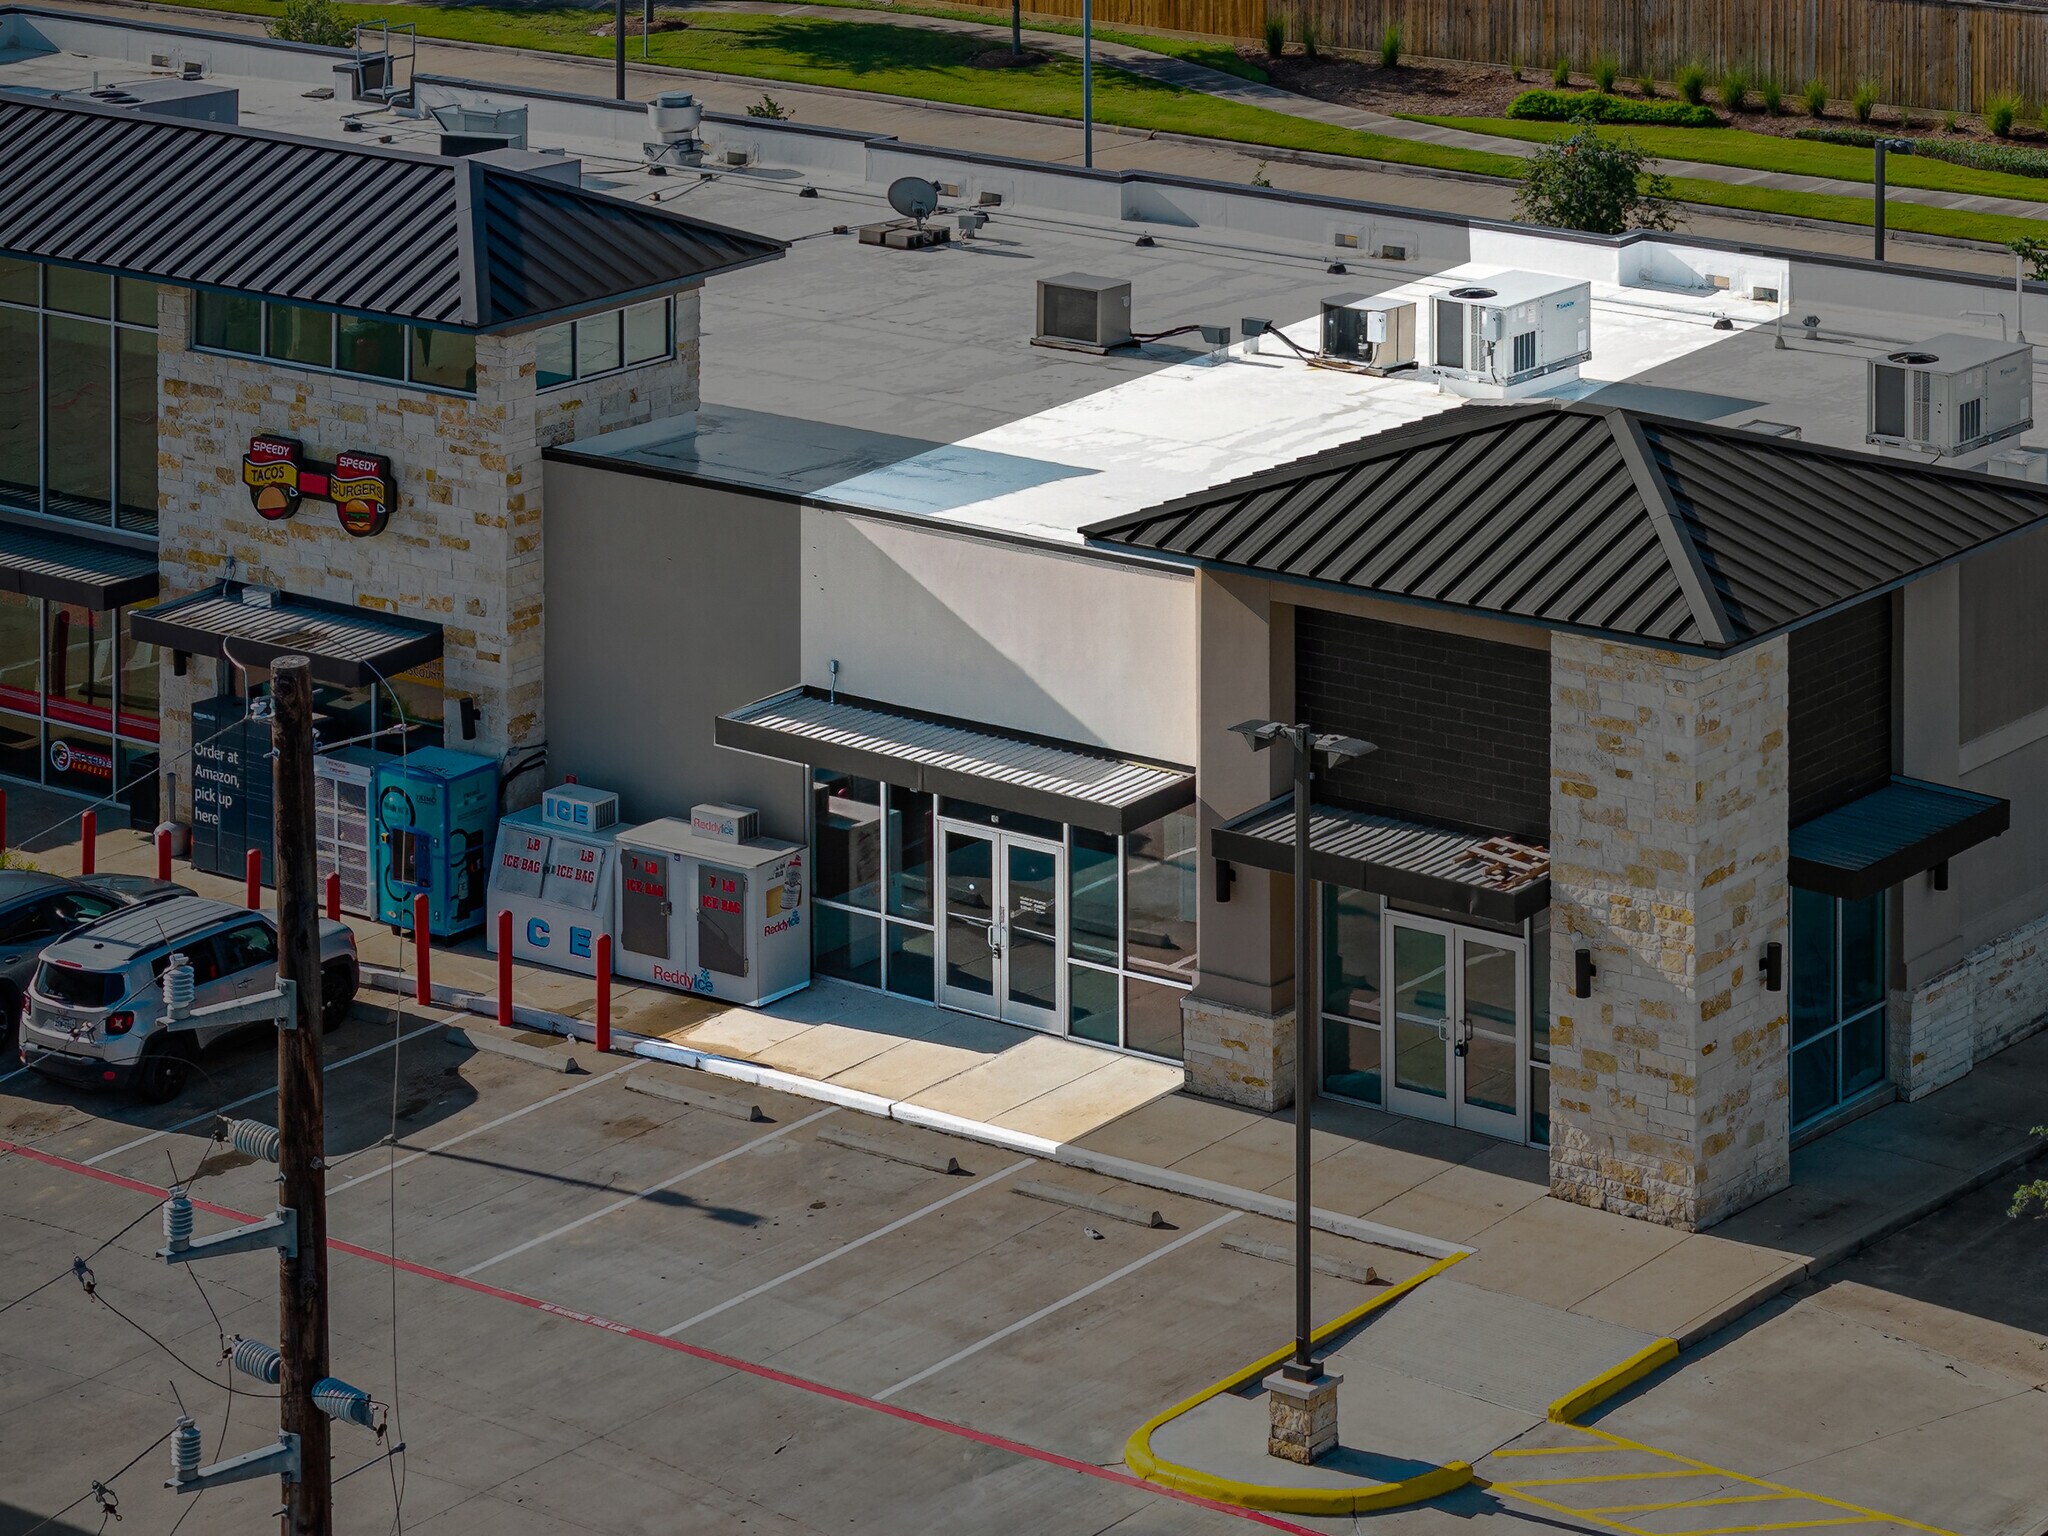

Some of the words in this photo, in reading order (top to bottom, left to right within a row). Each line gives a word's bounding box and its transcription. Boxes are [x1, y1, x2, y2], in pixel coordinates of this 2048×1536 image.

[253, 441, 290, 456] SPEEDY
[339, 456, 378, 472] SPEEDY
[251, 467, 284, 482] TACOS
[332, 479, 383, 499] BURGERS
[194, 742, 225, 761] Order
[227, 751, 239, 764] at
[195, 764, 240, 788] Amazon,
[195, 786, 216, 803] pick
[218, 791, 232, 809] up
[195, 807, 219, 825] here
[546, 798, 589, 825] ICE
[527, 837, 541, 852] LB
[503, 853, 520, 869] ICE
[521, 857, 541, 874] BAG
[580, 849, 595, 864] LB
[556, 864, 573, 879] ICE
[575, 868, 595, 883] BAG
[644, 860, 658, 875] LB
[625, 878, 642, 892] ICE
[644, 883, 665, 897] BAG
[709, 875, 716, 890] 7
[721, 878, 736, 894] LB
[702, 895, 719, 910] ICE
[721, 899, 742, 915] BAG
